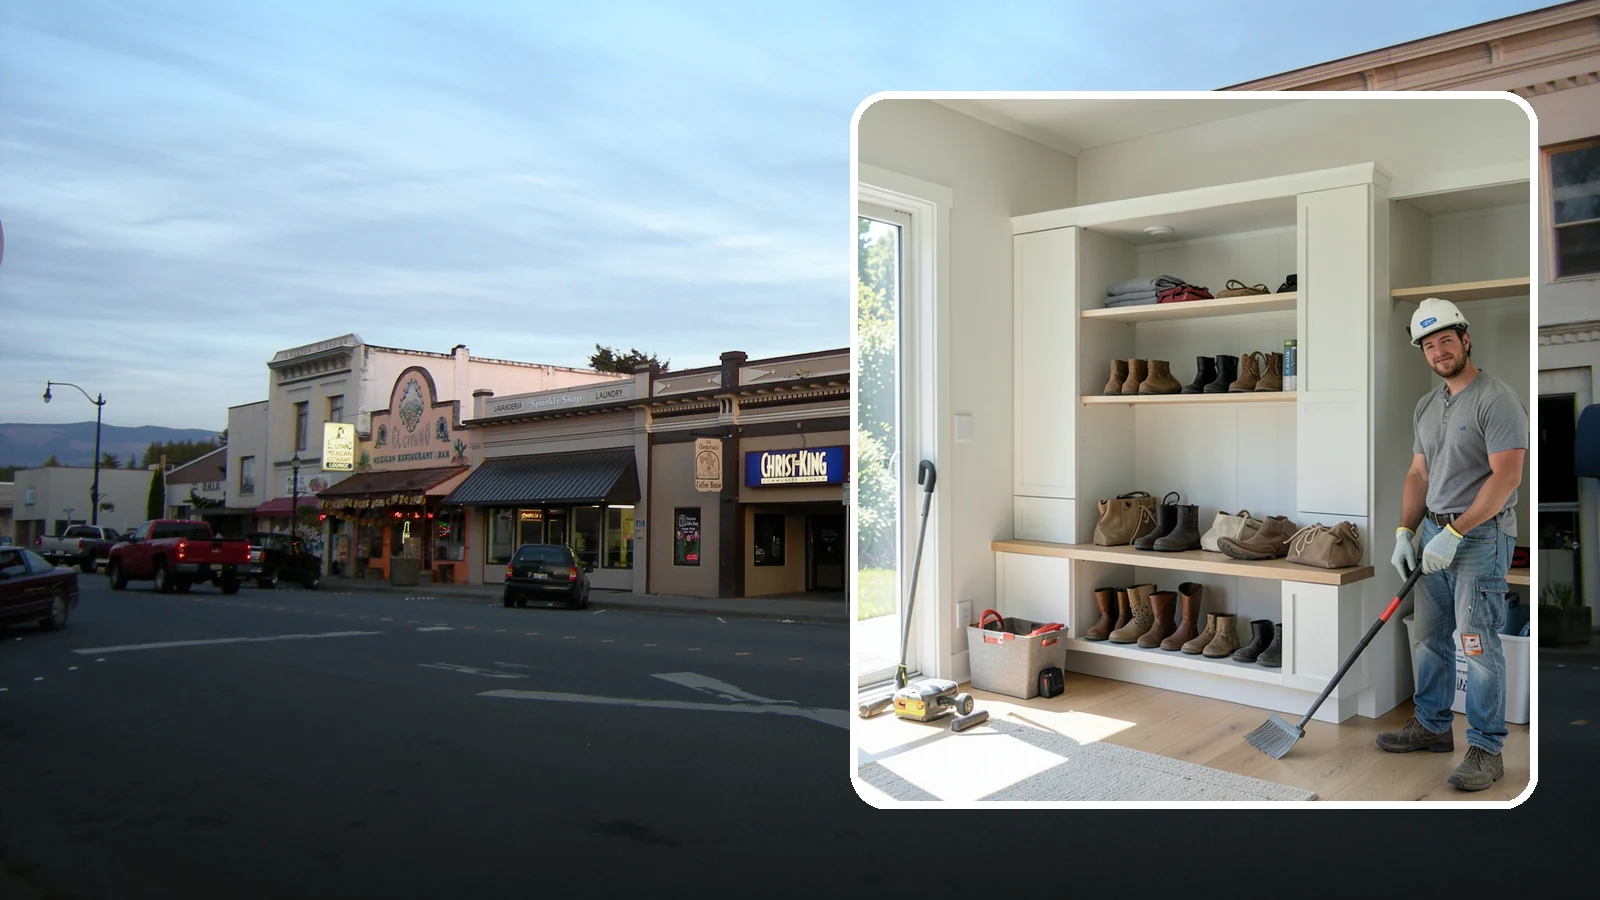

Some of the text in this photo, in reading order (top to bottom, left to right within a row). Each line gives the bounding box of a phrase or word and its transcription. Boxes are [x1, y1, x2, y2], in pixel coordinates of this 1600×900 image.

[561, 394, 583, 405] Shop
[595, 389, 624, 400] LAUNDRY
[493, 402, 523, 412] LAVANDERIA
[373, 450, 450, 464] MEXICAN RESTAURANT BAR
[760, 450, 827, 478] CHRIST KING
